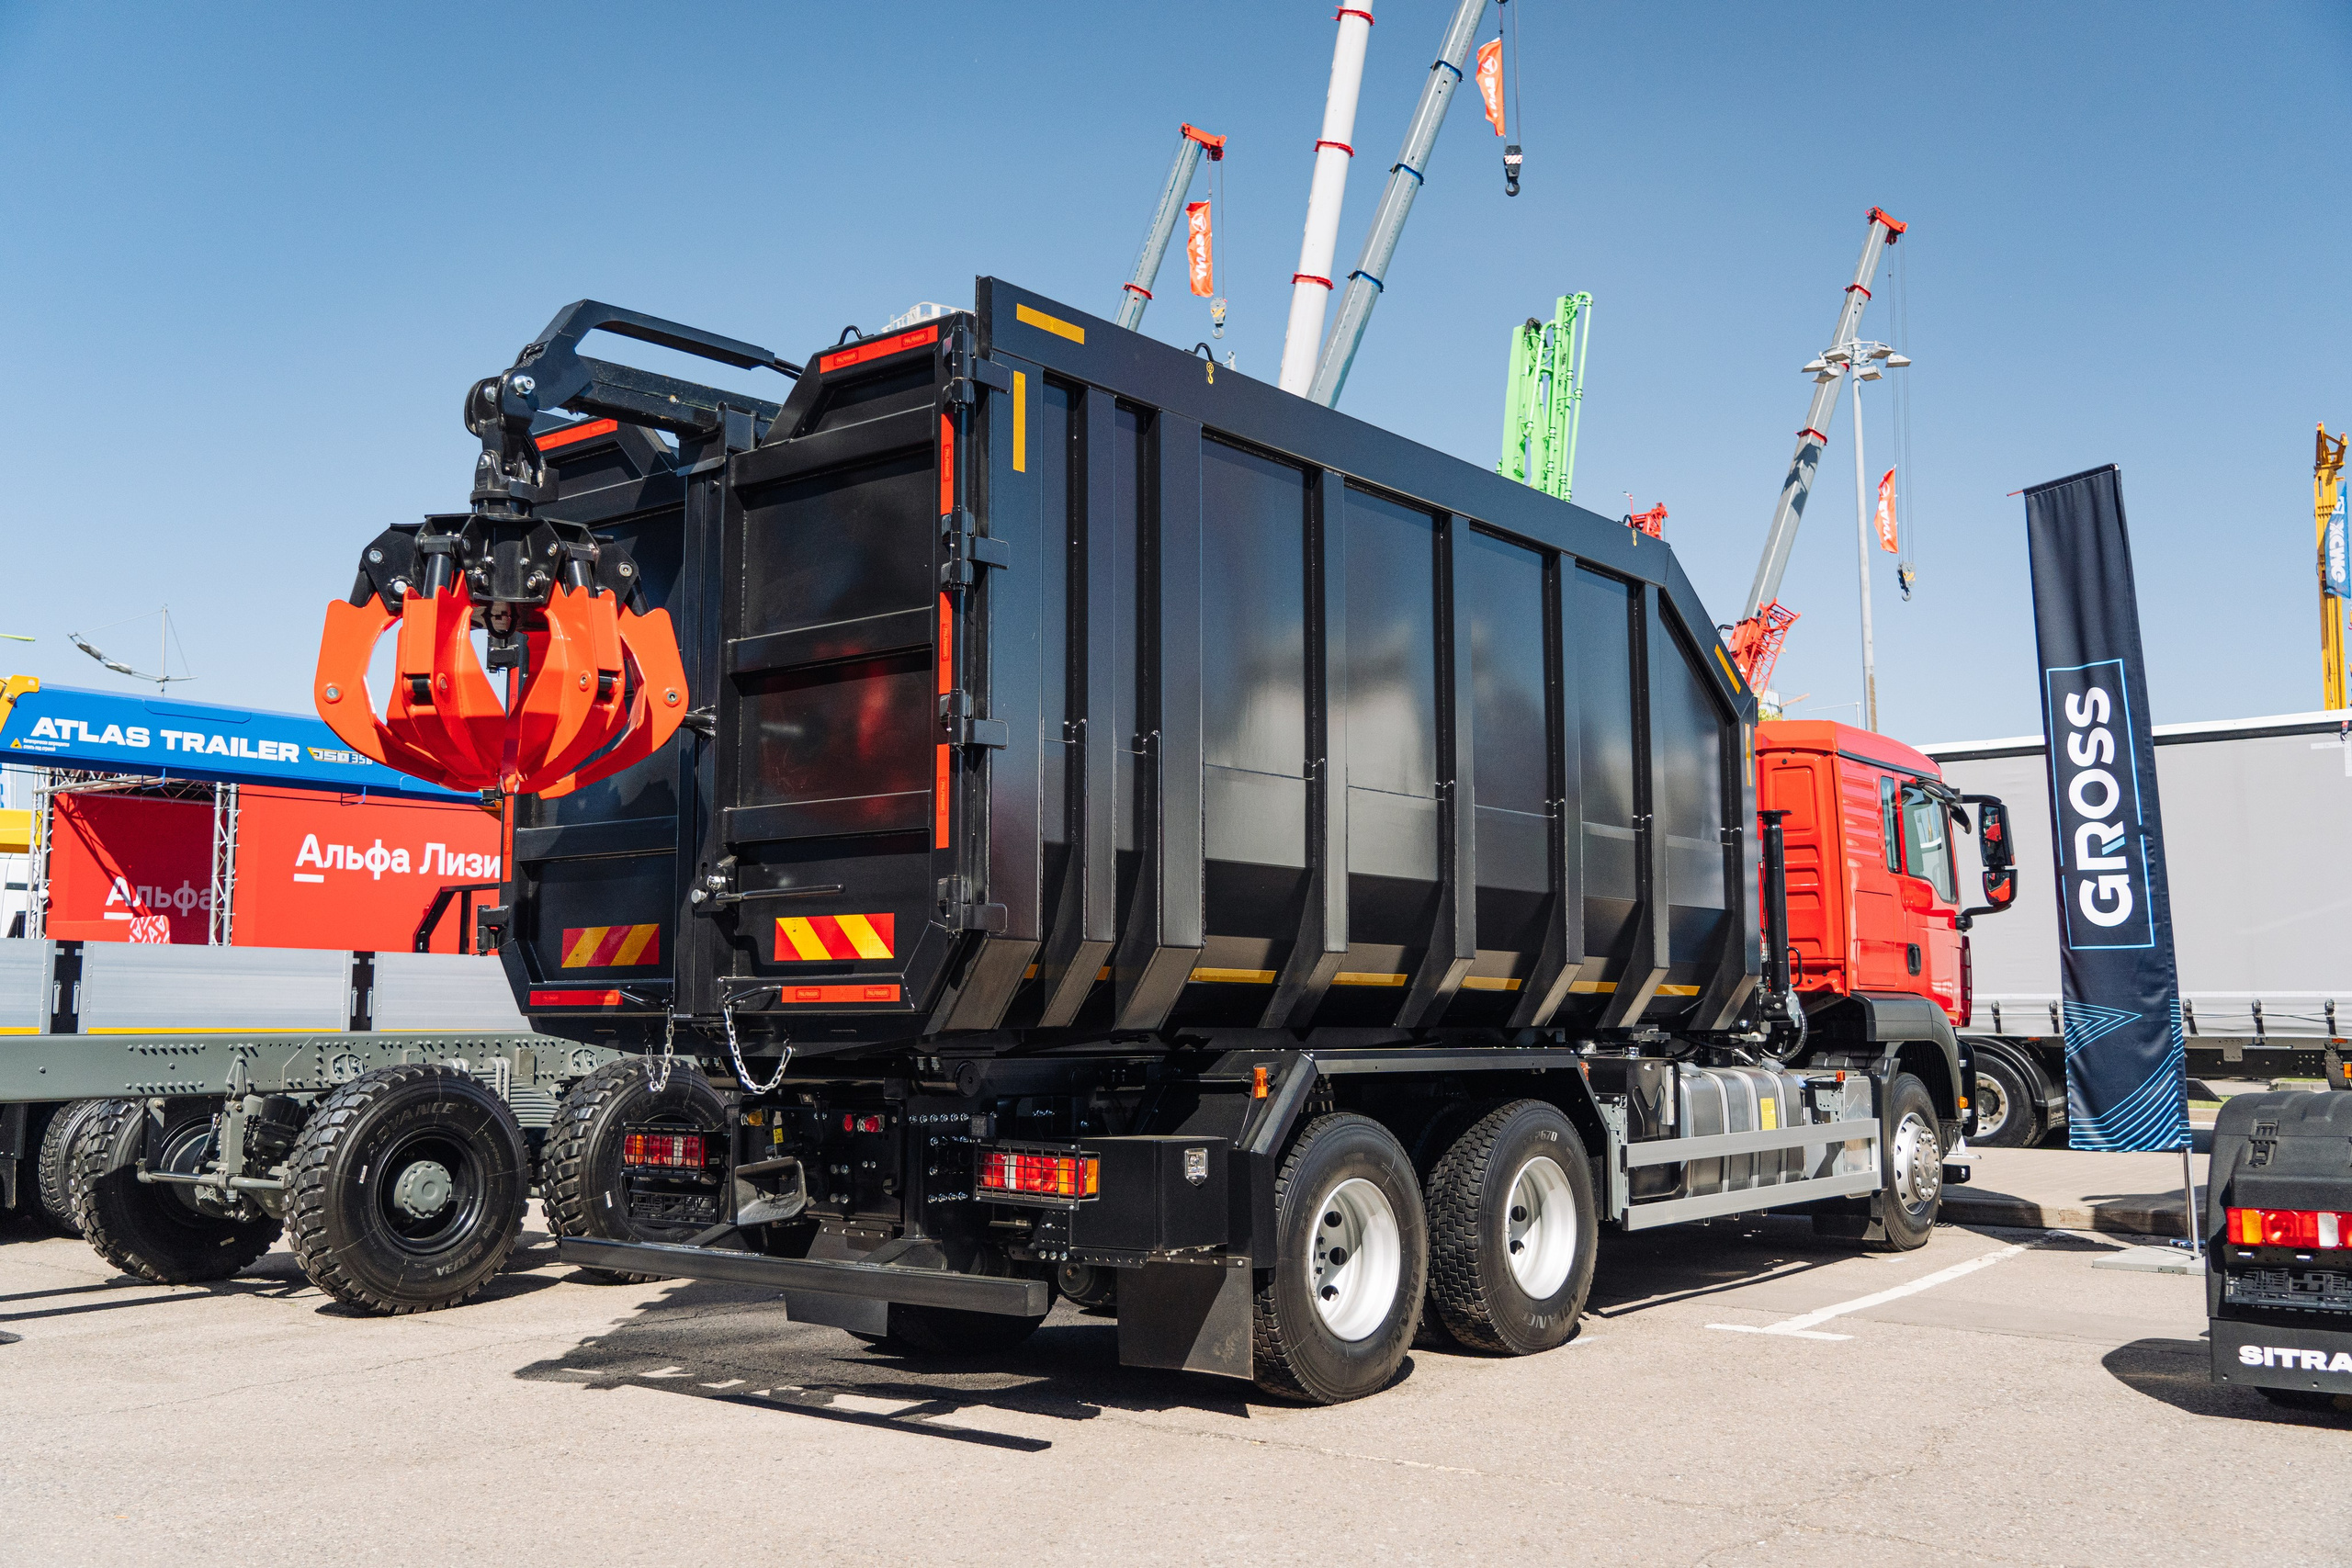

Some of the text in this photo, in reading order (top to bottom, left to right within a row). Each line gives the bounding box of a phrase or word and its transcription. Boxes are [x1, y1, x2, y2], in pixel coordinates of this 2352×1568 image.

[30, 716, 300, 763] ATLAS TRAILER
[2064, 686, 2134, 927] GROSS
[294, 833, 501, 881] Альфа Лизи
[104, 875, 212, 918] Альфа
[2238, 1345, 2352, 1374] SITRA
